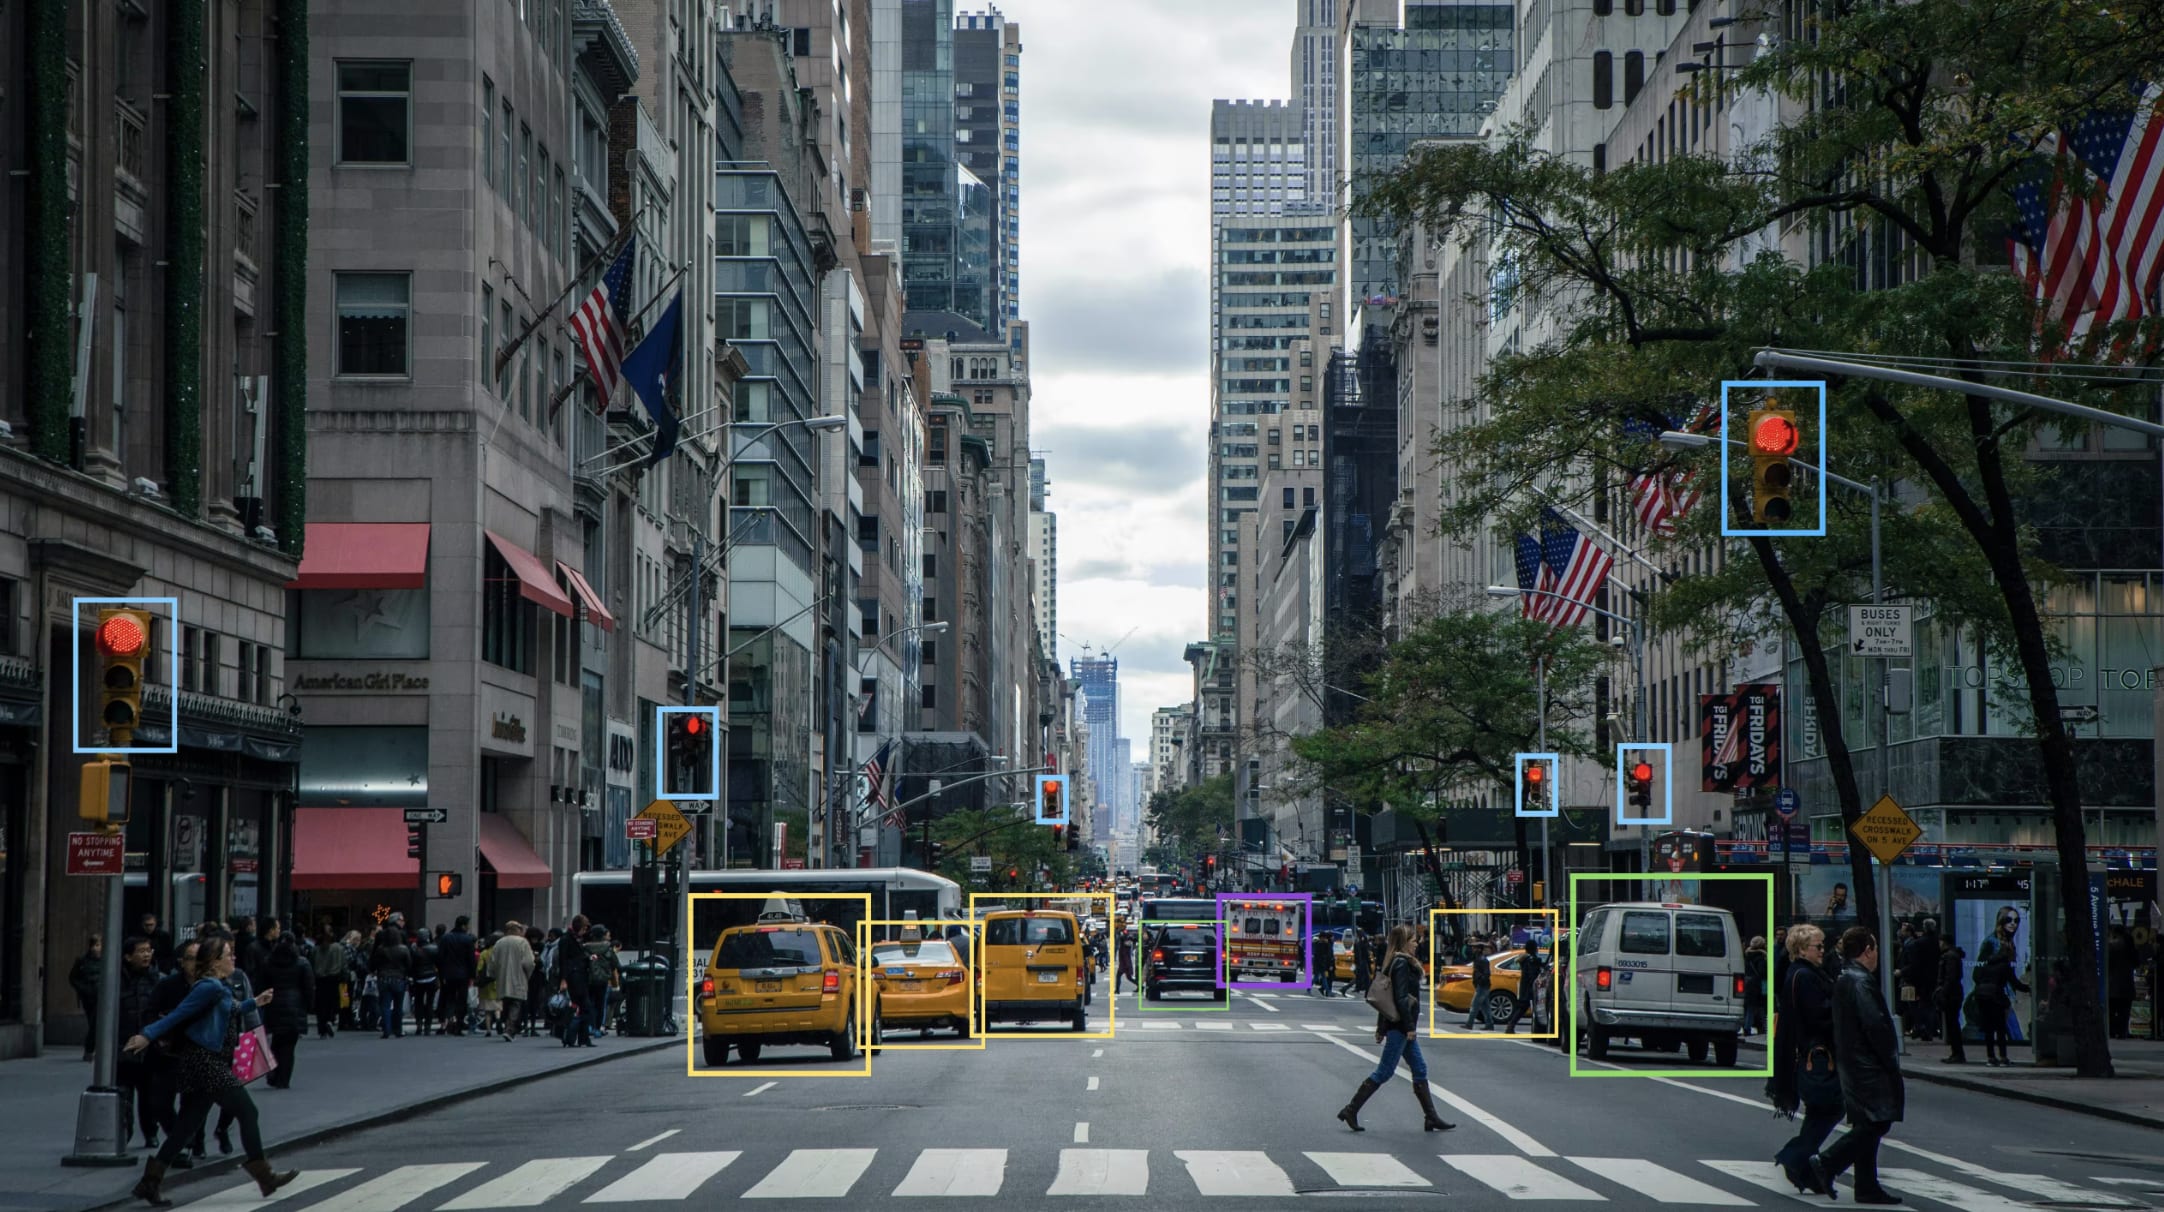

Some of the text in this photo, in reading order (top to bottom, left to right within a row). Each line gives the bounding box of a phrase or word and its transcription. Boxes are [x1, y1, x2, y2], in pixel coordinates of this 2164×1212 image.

[1861, 609, 1900, 619] BUSES
[1865, 627, 1896, 637] ONLY
[294, 672, 429, 689] American Girl Place
[1944, 665, 2084, 689] TOPSOP
[1749, 696, 1764, 704] TGI
[1713, 705, 1728, 714] TGI
[1749, 705, 1765, 775] FRIDAYS
[1713, 714, 1728, 780] FRIDYS
[1866, 816, 1908, 825] RECESSED
[1862, 826, 1912, 835] CROSSWALK
[72, 836, 121, 846] NO STOPPING
[1882, 836, 1888, 844] 5
[77, 848, 115, 857] ANYTIME
